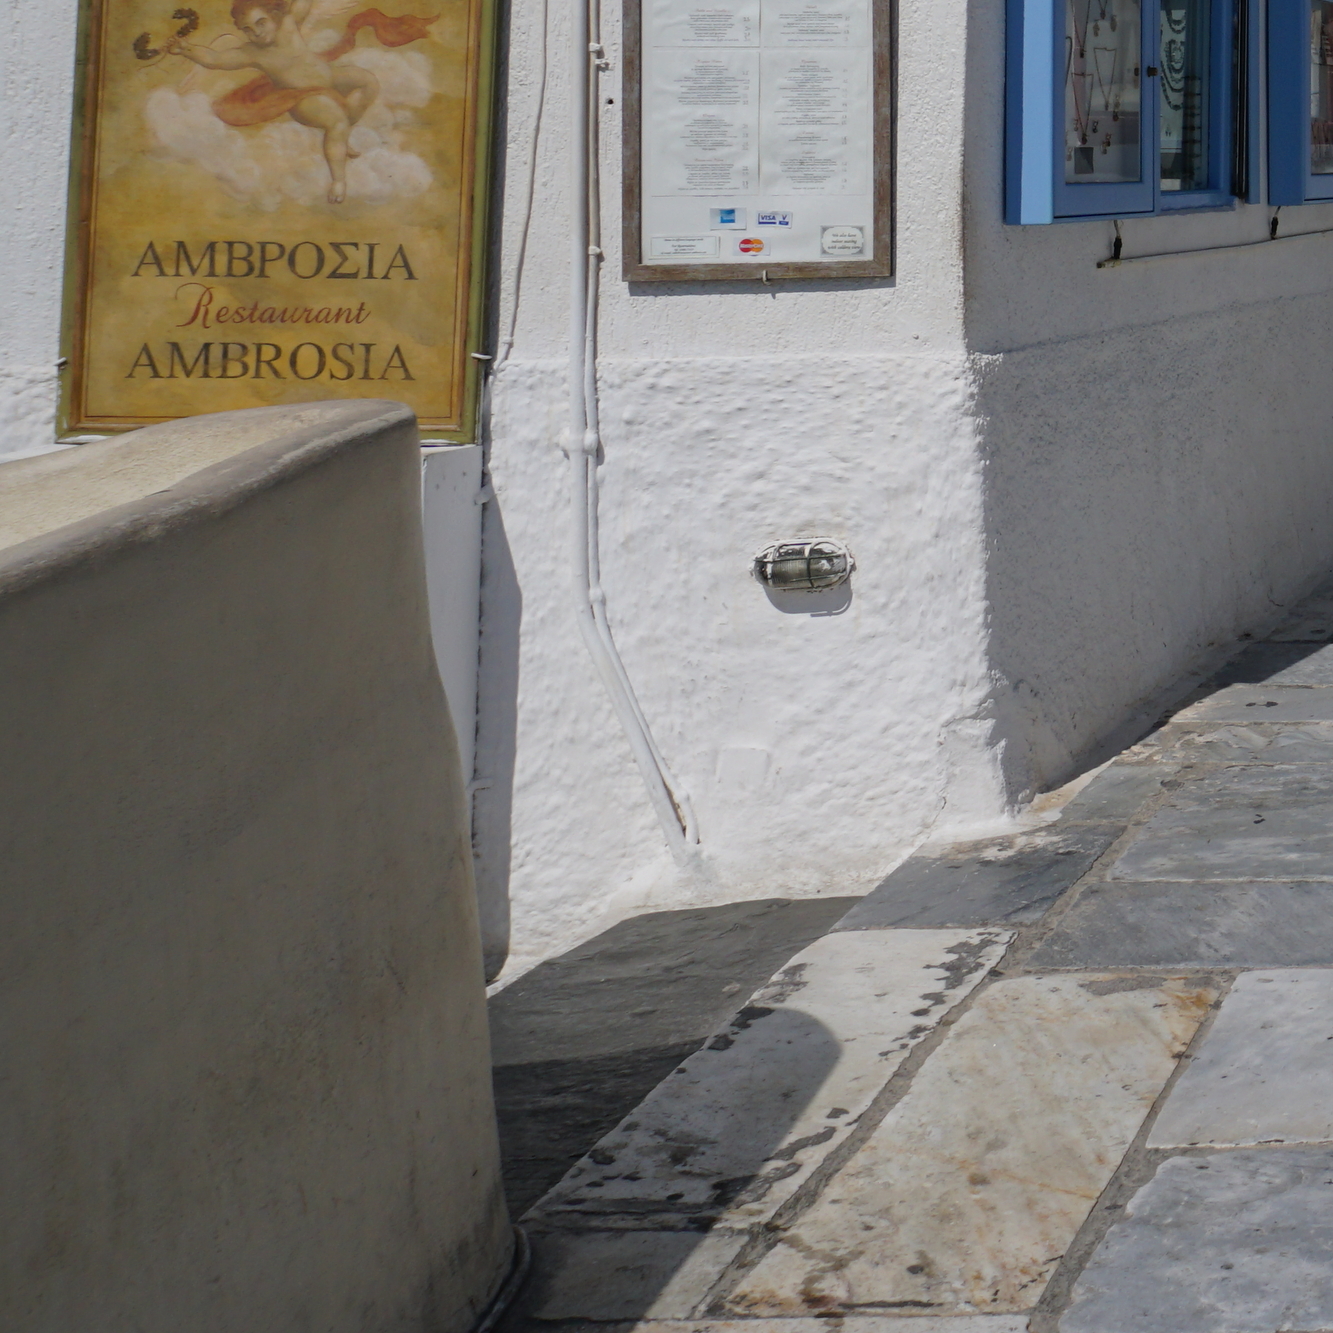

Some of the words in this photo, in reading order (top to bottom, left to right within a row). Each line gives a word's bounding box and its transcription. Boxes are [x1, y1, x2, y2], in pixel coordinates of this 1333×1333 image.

[130, 239, 419, 282] ΑΜΒΡΟΣΙΑ
[175, 282, 372, 329] Restaurant
[125, 341, 417, 382] AMBROSIA
